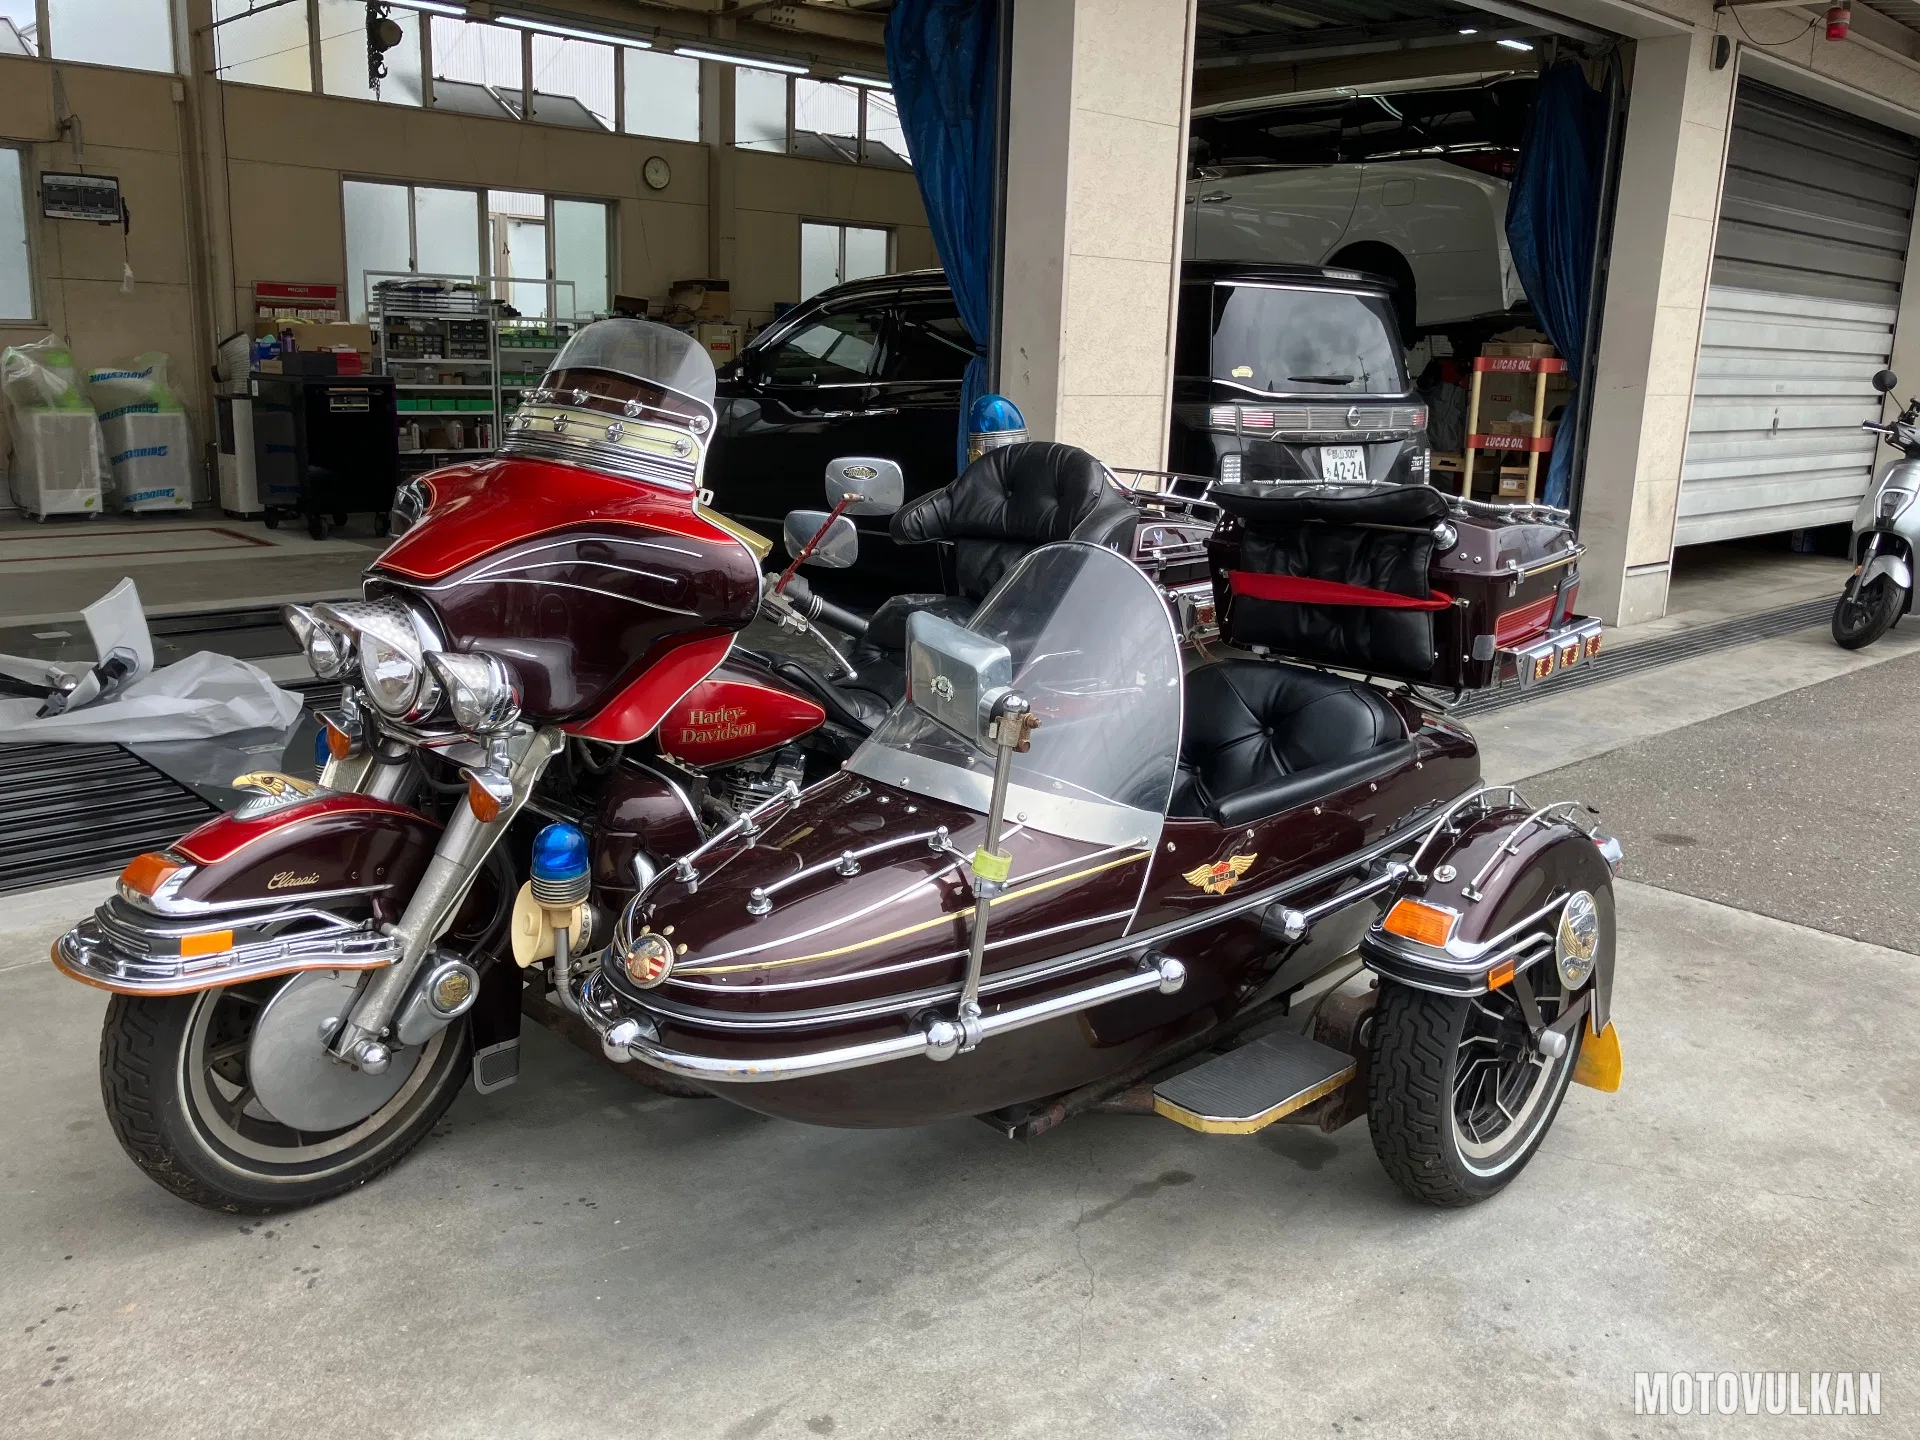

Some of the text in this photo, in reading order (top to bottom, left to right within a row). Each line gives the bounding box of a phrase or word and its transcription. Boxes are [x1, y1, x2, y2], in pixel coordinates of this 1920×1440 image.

[1492, 360, 1531, 371] LUCAS OIL
[1485, 437, 1523, 448] LUCAS OIL
[1344, 449, 1355, 459] 300
[1334, 461, 1364, 480] 42-24
[688, 705, 747, 725] Harley-
[680, 722, 756, 744] Davidson
[267, 871, 320, 890] Classic
